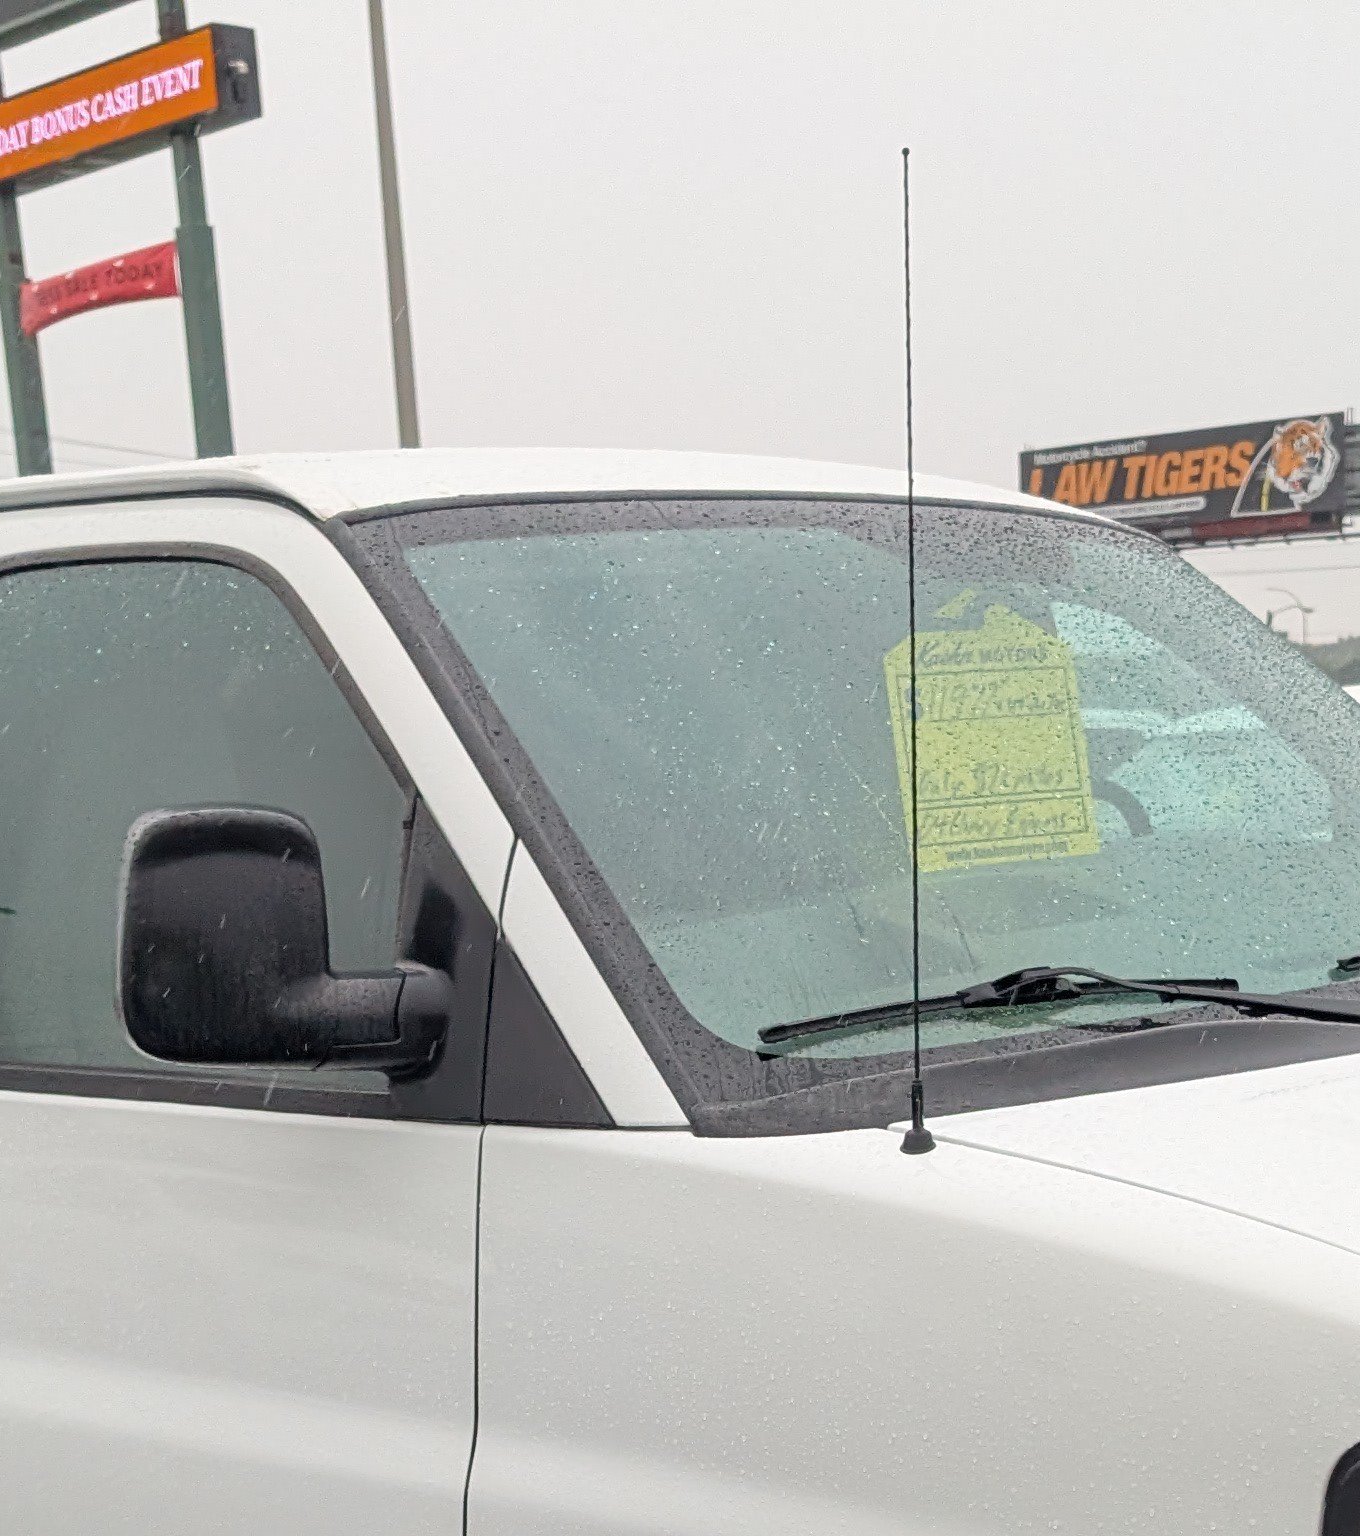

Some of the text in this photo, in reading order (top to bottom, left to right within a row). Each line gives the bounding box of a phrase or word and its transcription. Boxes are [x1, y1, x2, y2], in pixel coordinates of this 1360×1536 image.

[31, 99, 91, 145] BONUS
[90, 83, 140, 123] CASH
[141, 59, 204, 107] EVENT
[1122, 439, 1257, 500] TIGERS
